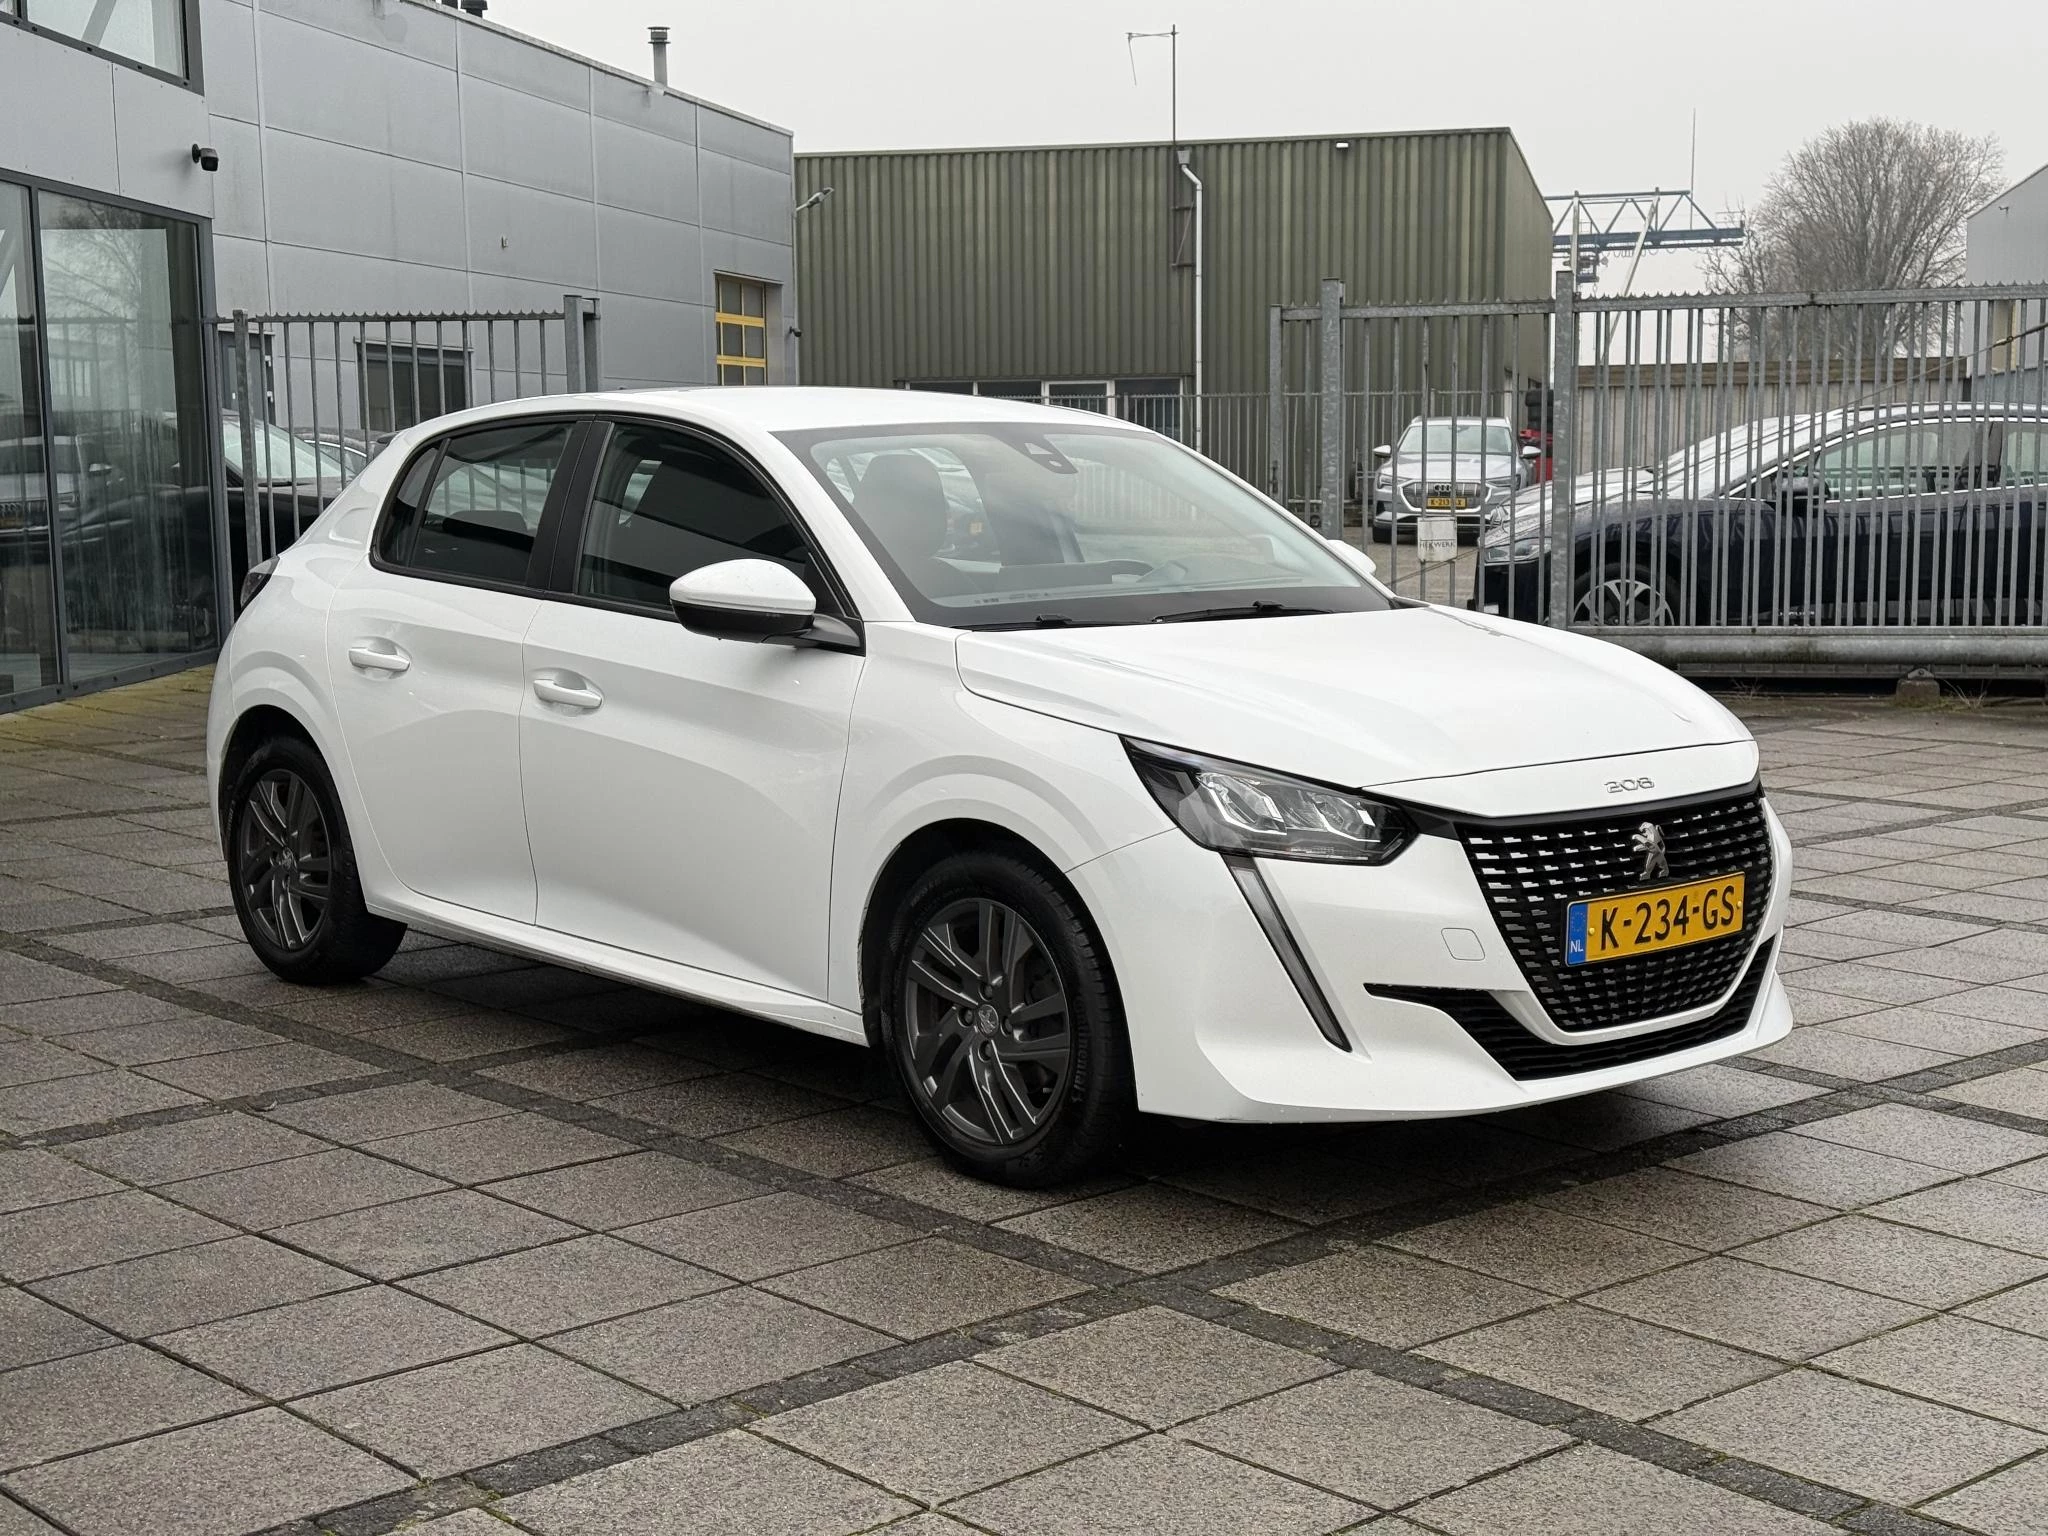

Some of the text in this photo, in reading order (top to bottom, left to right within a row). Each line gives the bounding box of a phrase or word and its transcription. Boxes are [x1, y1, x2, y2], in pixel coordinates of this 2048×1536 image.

[1419, 541, 1456, 549] HEKWERK
[1604, 777, 1655, 794] 208
[1600, 885, 1735, 951] K-234-GS
[1569, 939, 1584, 953] NL
